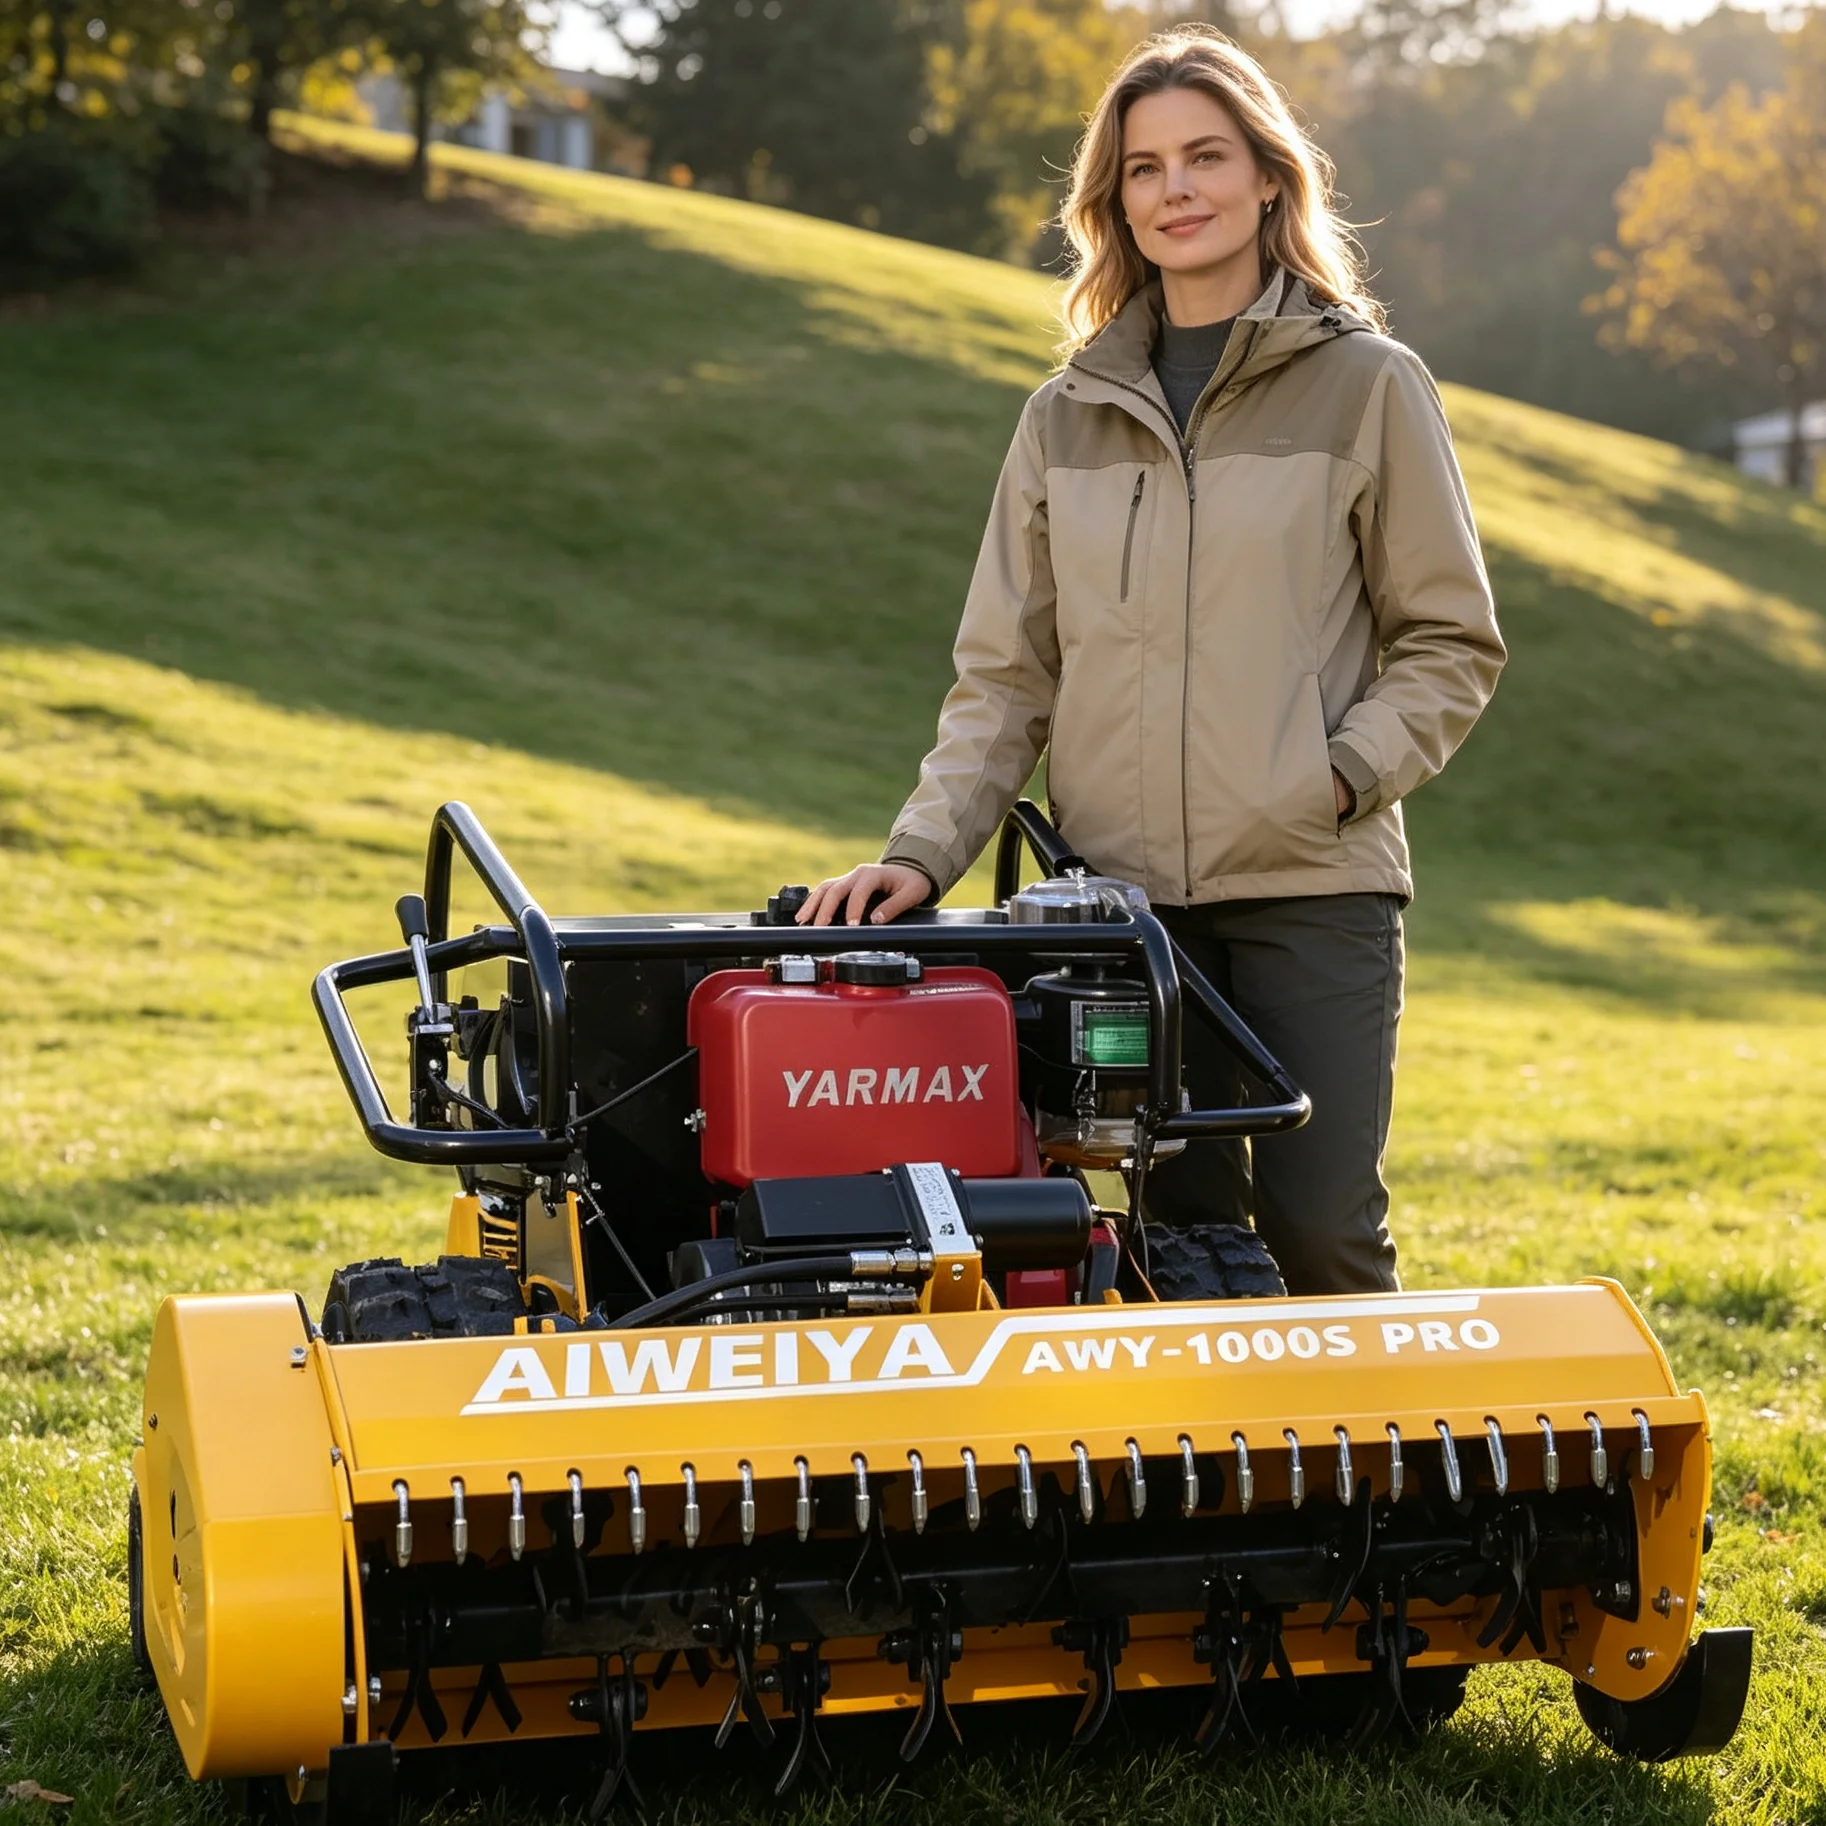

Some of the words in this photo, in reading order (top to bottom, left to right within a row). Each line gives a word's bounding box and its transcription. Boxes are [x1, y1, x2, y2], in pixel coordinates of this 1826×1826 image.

[782, 1063, 989, 1108] YARMAX
[475, 1324, 955, 1402] AIWEIYA
[1022, 1325, 1357, 1375] AWY-1000S
[1381, 1318, 1501, 1354] PRO
